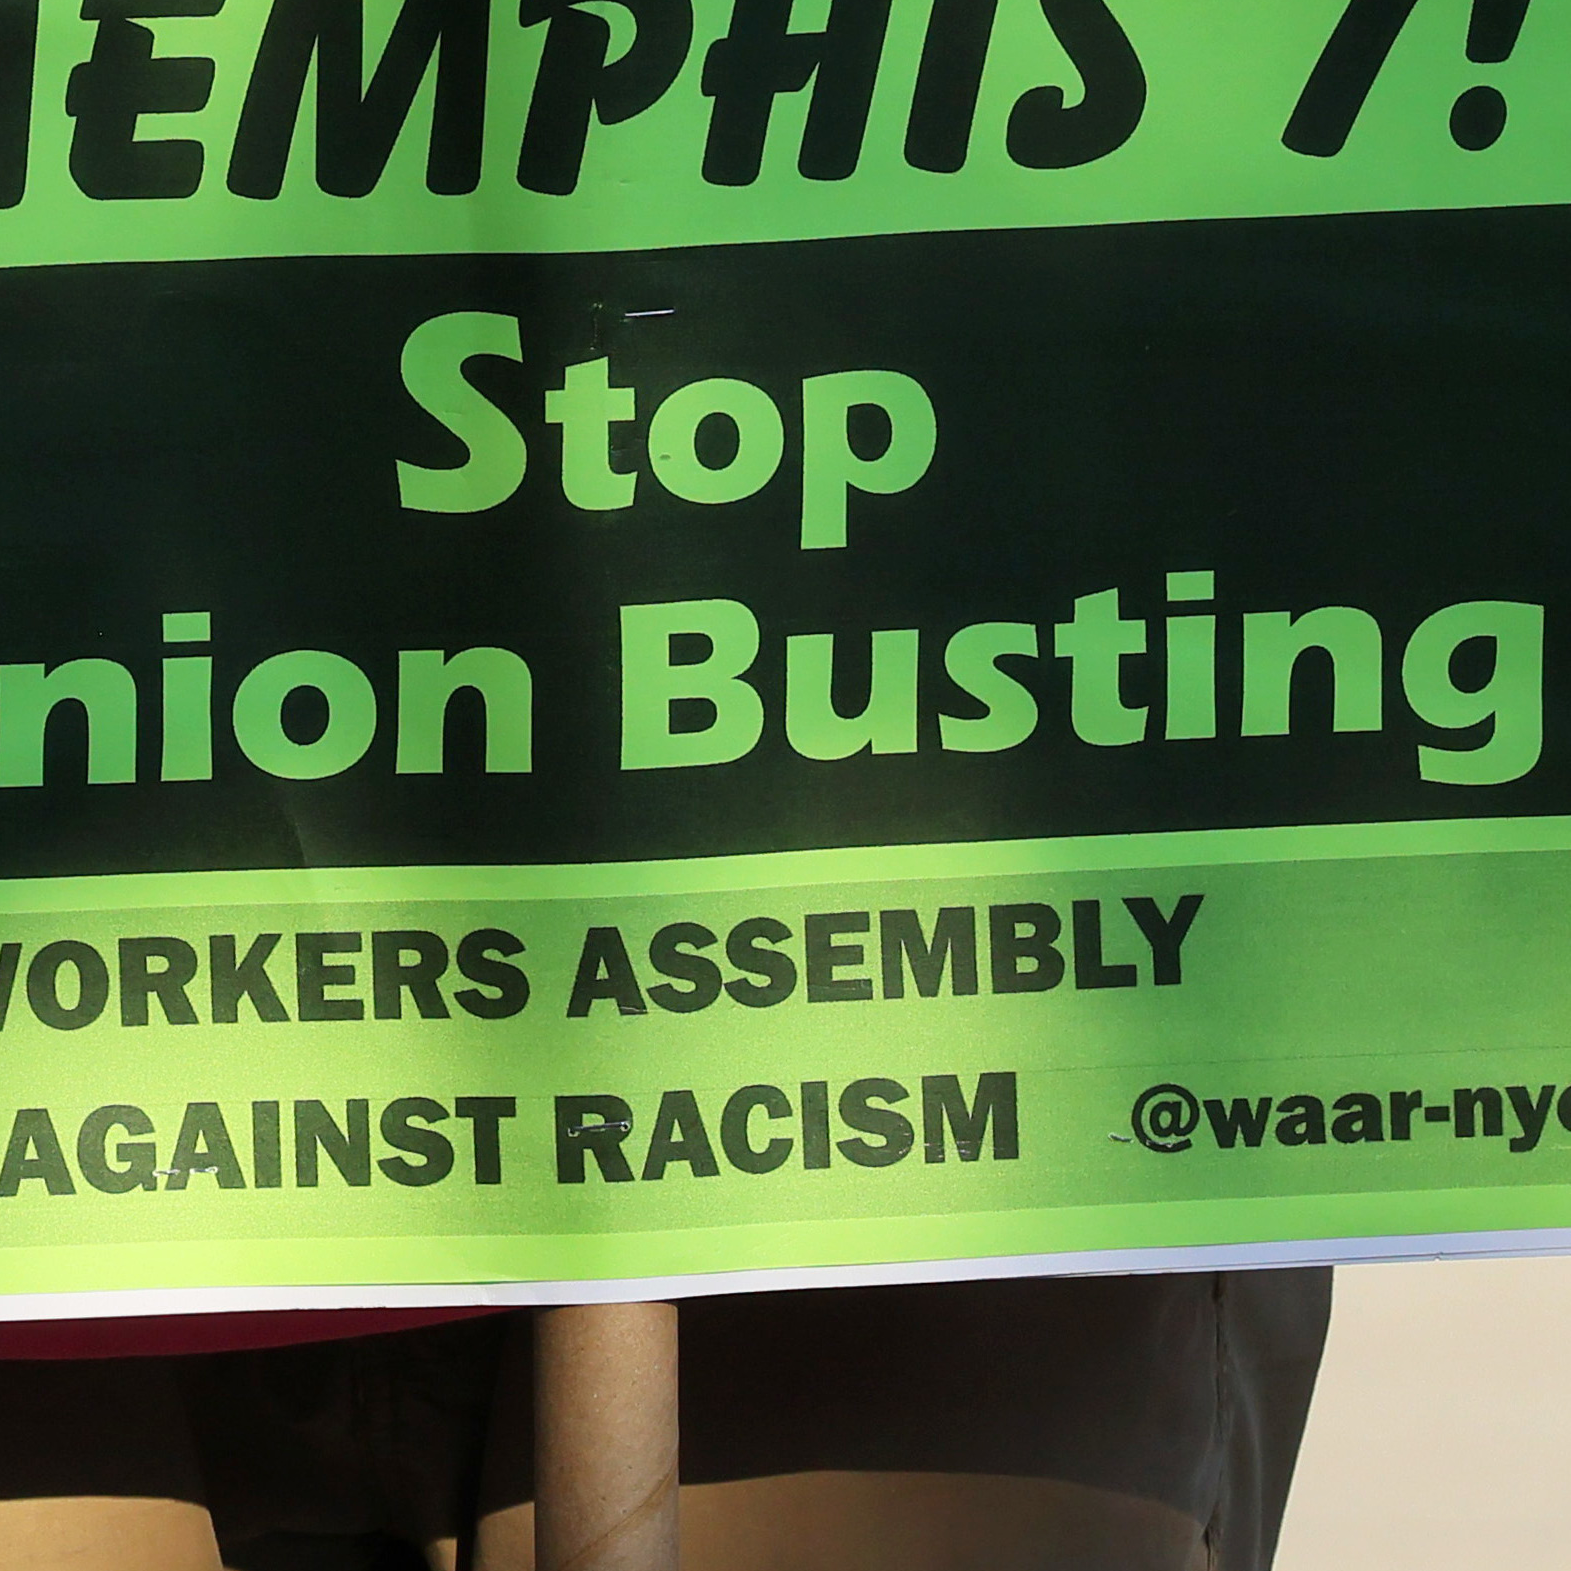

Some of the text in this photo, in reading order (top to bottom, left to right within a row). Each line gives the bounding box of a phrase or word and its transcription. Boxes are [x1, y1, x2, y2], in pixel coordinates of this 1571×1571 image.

[395, 311, 937, 550] Stop
[618, 570, 1547, 788] Busting
[565, 892, 1207, 1020] ASSEMBLY
[553, 1070, 1021, 1185] RACISM
